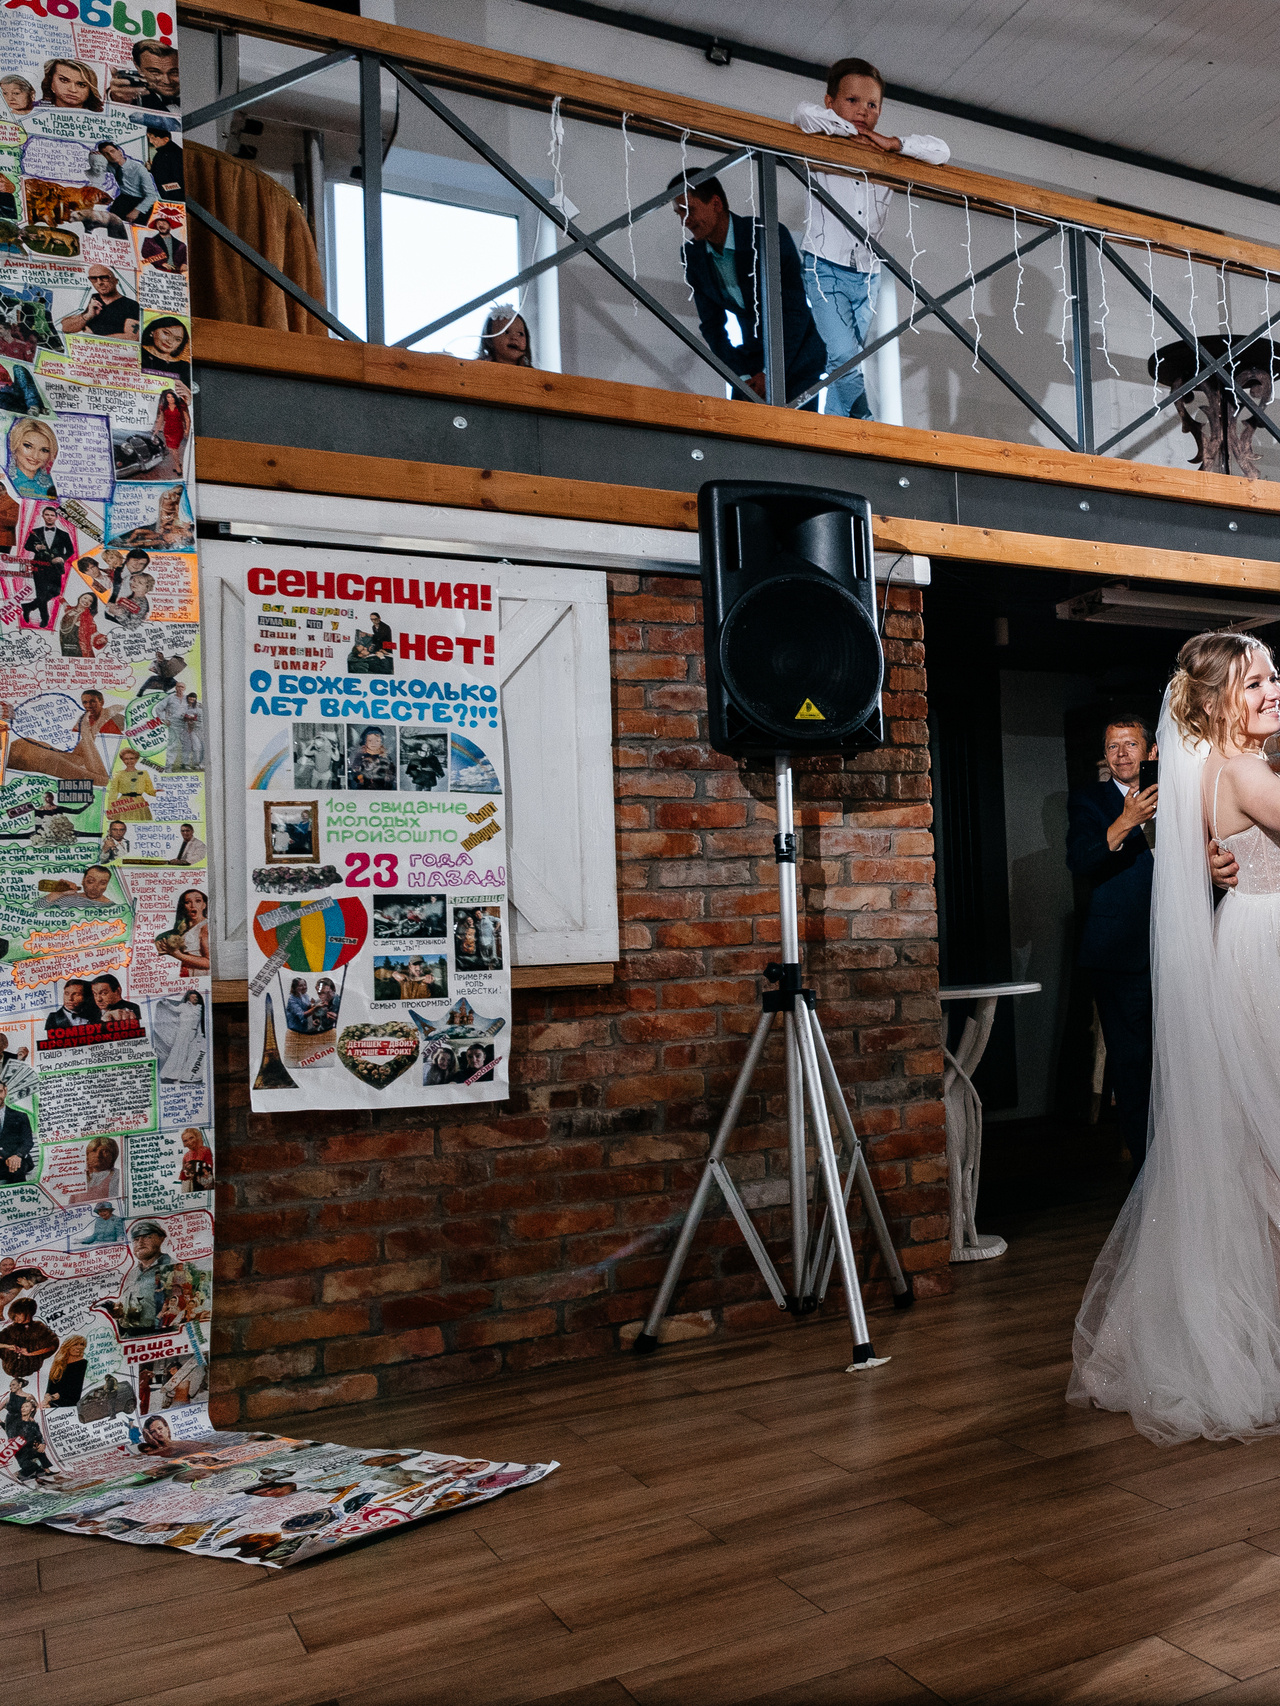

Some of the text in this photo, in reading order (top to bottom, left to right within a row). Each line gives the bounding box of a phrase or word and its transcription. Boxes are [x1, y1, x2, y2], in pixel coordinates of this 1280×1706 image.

[4, 259, 47, 270] Дмитрий
[259, 629, 297, 641] Паши
[250, 669, 498, 703] О БОЖЕ, СКОЛЬКО
[250, 696, 309, 717] ЛЕТ
[105, 801, 150, 816] МАЛЫШЕВА
[111, 797, 135, 808] ЕЛЕНА
[368, 800, 468, 816] свидание
[345, 852, 474, 888] 23 ГОДА
[407, 865, 506, 888] НАЗАД!
[47, 1018, 140, 1040] COMEDY CLUB
[347, 1040, 382, 1049] ДЕТИШЕК
[123, 1339, 173, 1356] Паша
[127, 1344, 189, 1365] может!
